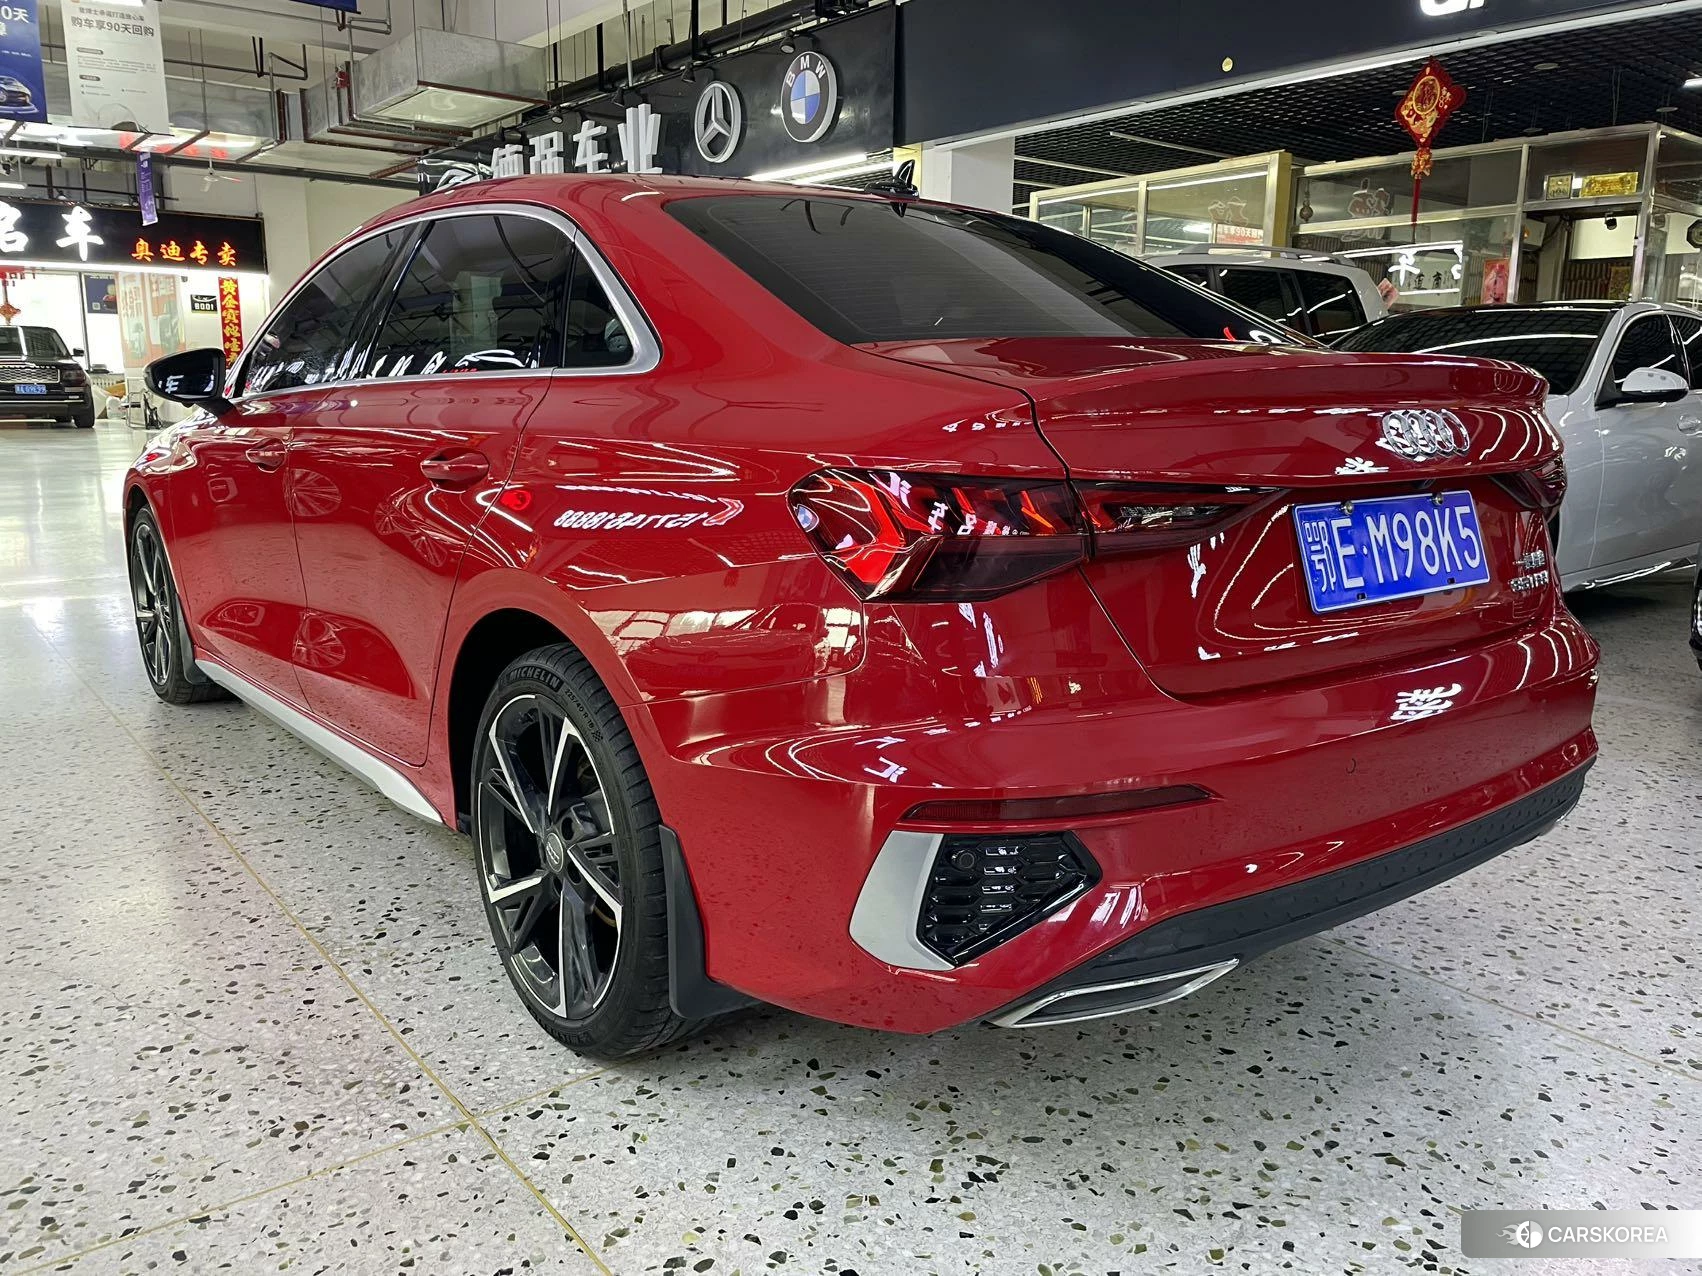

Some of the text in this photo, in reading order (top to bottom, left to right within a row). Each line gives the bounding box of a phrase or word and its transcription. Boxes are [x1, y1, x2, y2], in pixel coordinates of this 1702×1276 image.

[70, 15, 155, 37] 购车享90天回购
[786, 55, 826, 87] BMW
[131, 237, 237, 267] 奥迪专卖
[510, 666, 560, 689] MICHELIN
[564, 688, 584, 713] 225/40
